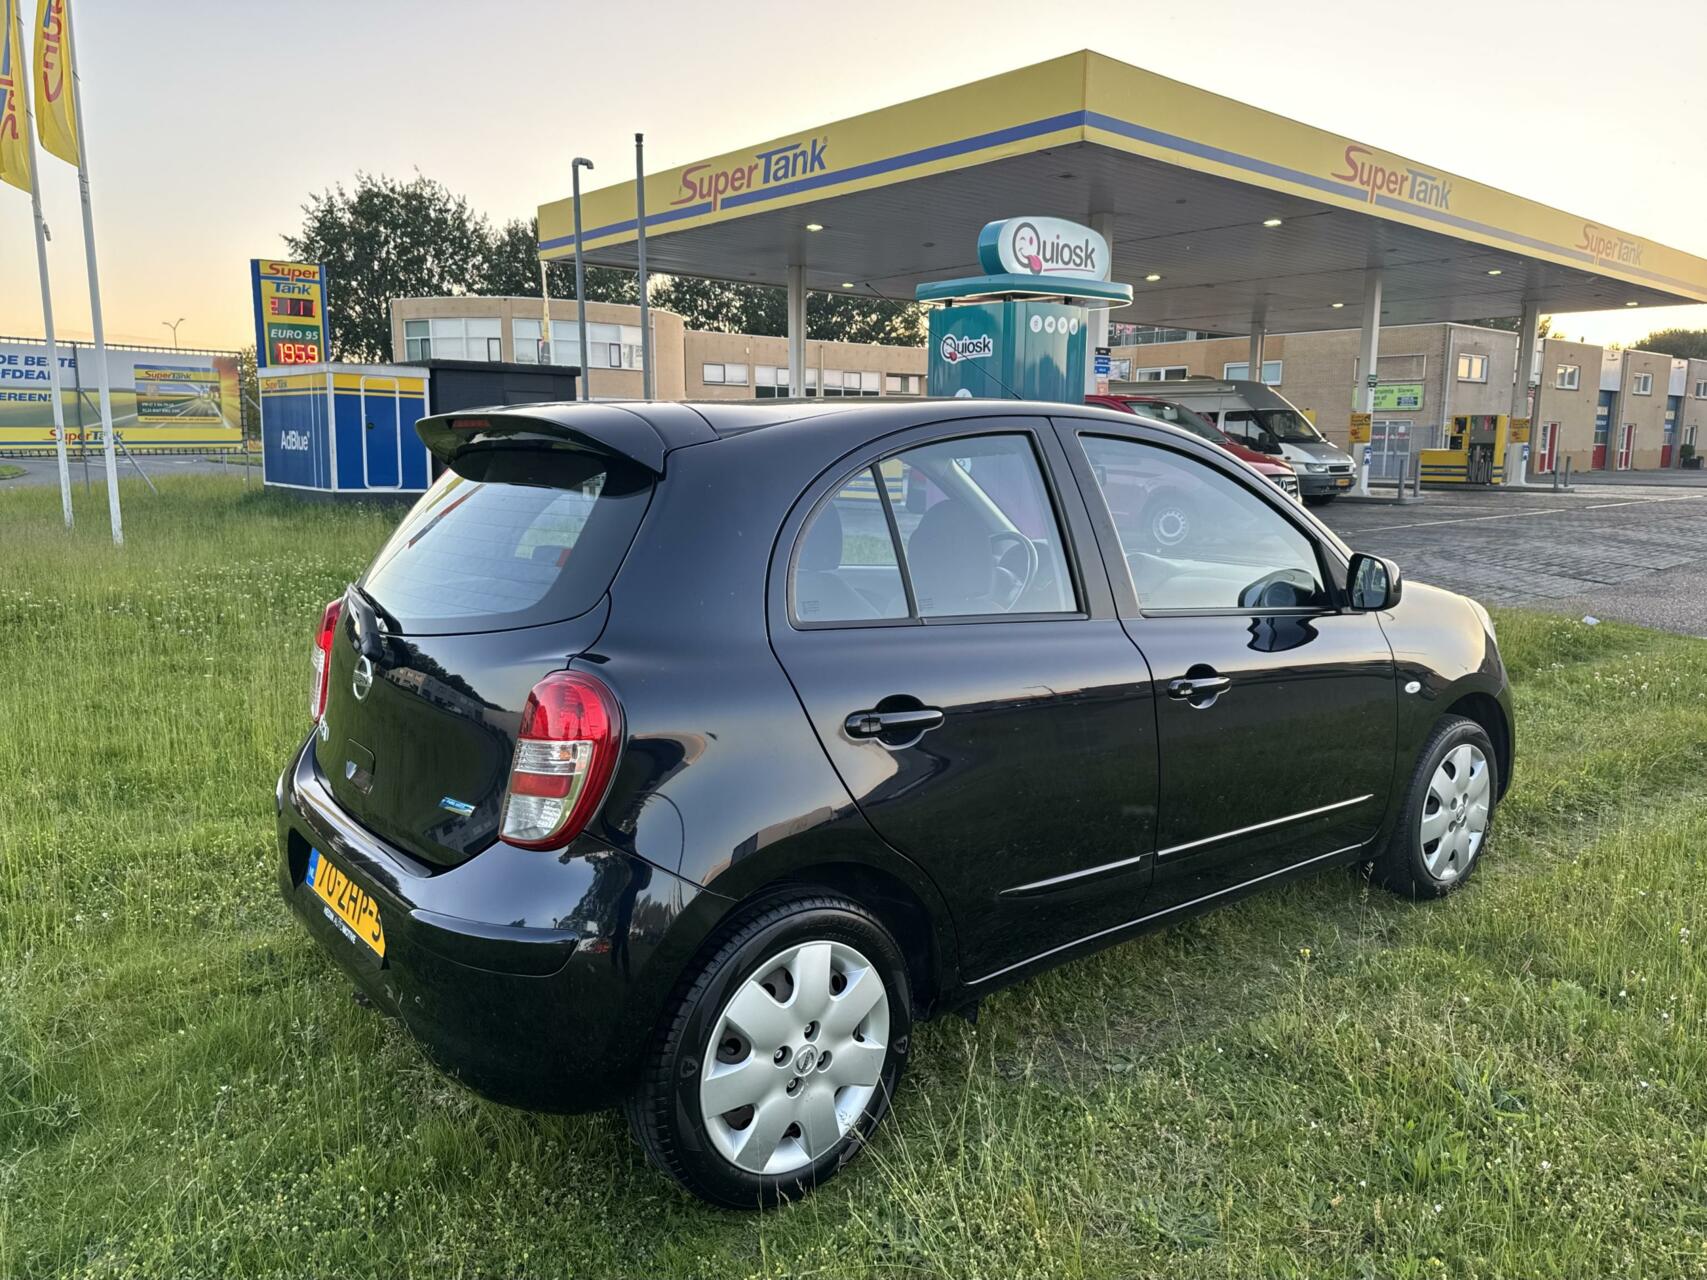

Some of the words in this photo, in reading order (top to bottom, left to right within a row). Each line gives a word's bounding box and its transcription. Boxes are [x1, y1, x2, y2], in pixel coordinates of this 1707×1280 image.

[670, 138, 827, 212] SuperTank
[1330, 145, 1452, 210] SuperTank
[1012, 222, 1096, 275] Quiosk
[1575, 223, 1645, 266] SuperTank
[260, 262, 318, 282] Super
[271, 281, 311, 295] Tank
[270, 328, 303, 340] EURO
[305, 330, 319, 341] 95
[942, 336, 991, 361] Quiosk
[24, 355, 77, 369] BETE
